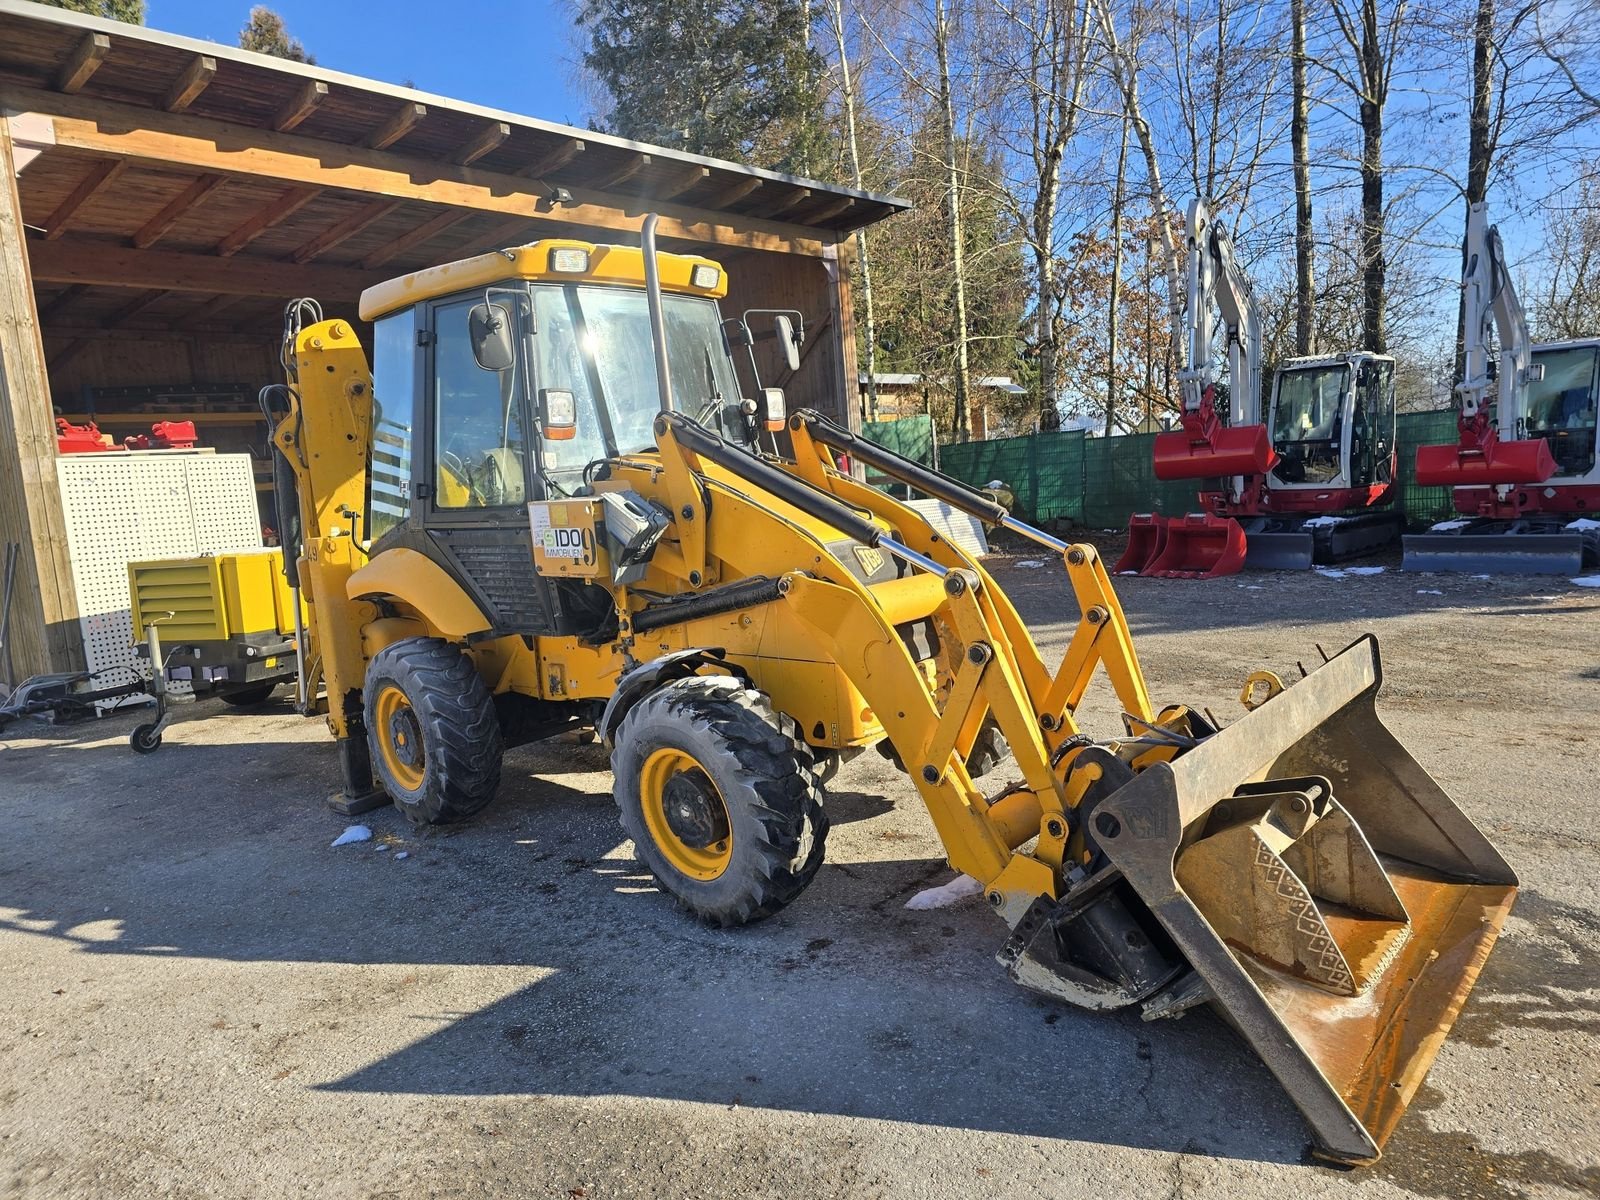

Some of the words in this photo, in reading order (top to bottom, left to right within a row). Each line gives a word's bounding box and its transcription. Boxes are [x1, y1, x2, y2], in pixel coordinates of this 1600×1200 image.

[543, 529, 581, 547] SIDO
[546, 549, 583, 558] IMMOBILIEN
[857, 548, 882, 573] JCB
